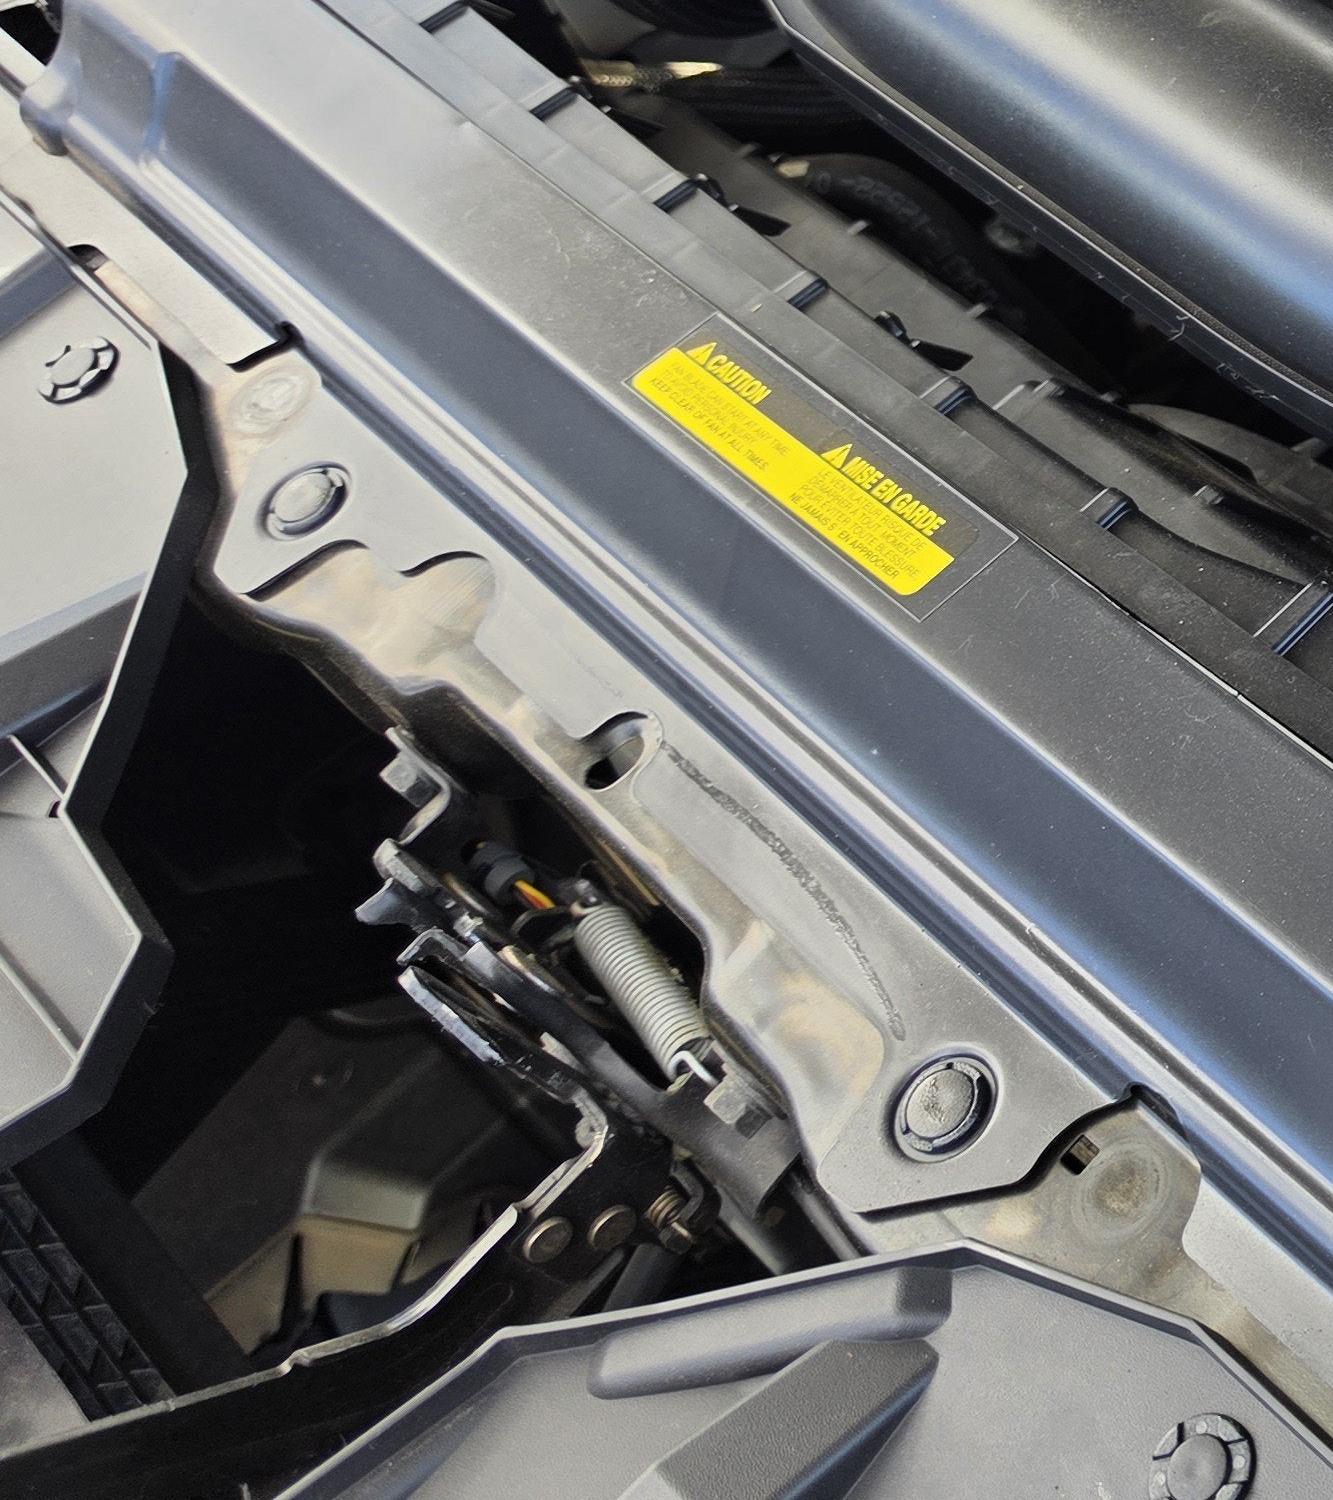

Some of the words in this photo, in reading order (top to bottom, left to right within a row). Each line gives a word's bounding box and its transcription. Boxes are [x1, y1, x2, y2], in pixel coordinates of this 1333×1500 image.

[649, 377, 672, 394] KEEP
[692, 410, 706, 421] OF
[717, 430, 731, 440] AT
[727, 438, 744, 451] ALL
[708, 354, 772, 405] CAUTION
[818, 467, 831, 478] LE
[829, 475, 883, 517] VENTILATEUR
[910, 537, 926, 550] DE
[841, 456, 884, 490] MISE
[870, 477, 902, 504] EN
[889, 492, 947, 537] GARDE
[858, 512, 881, 531] TOUT
[788, 492, 802, 504] NE
[799, 501, 830, 525] JAMAIS
[848, 539, 899, 578] APPROCHER
[849, 522, 878, 546] TOUTE
